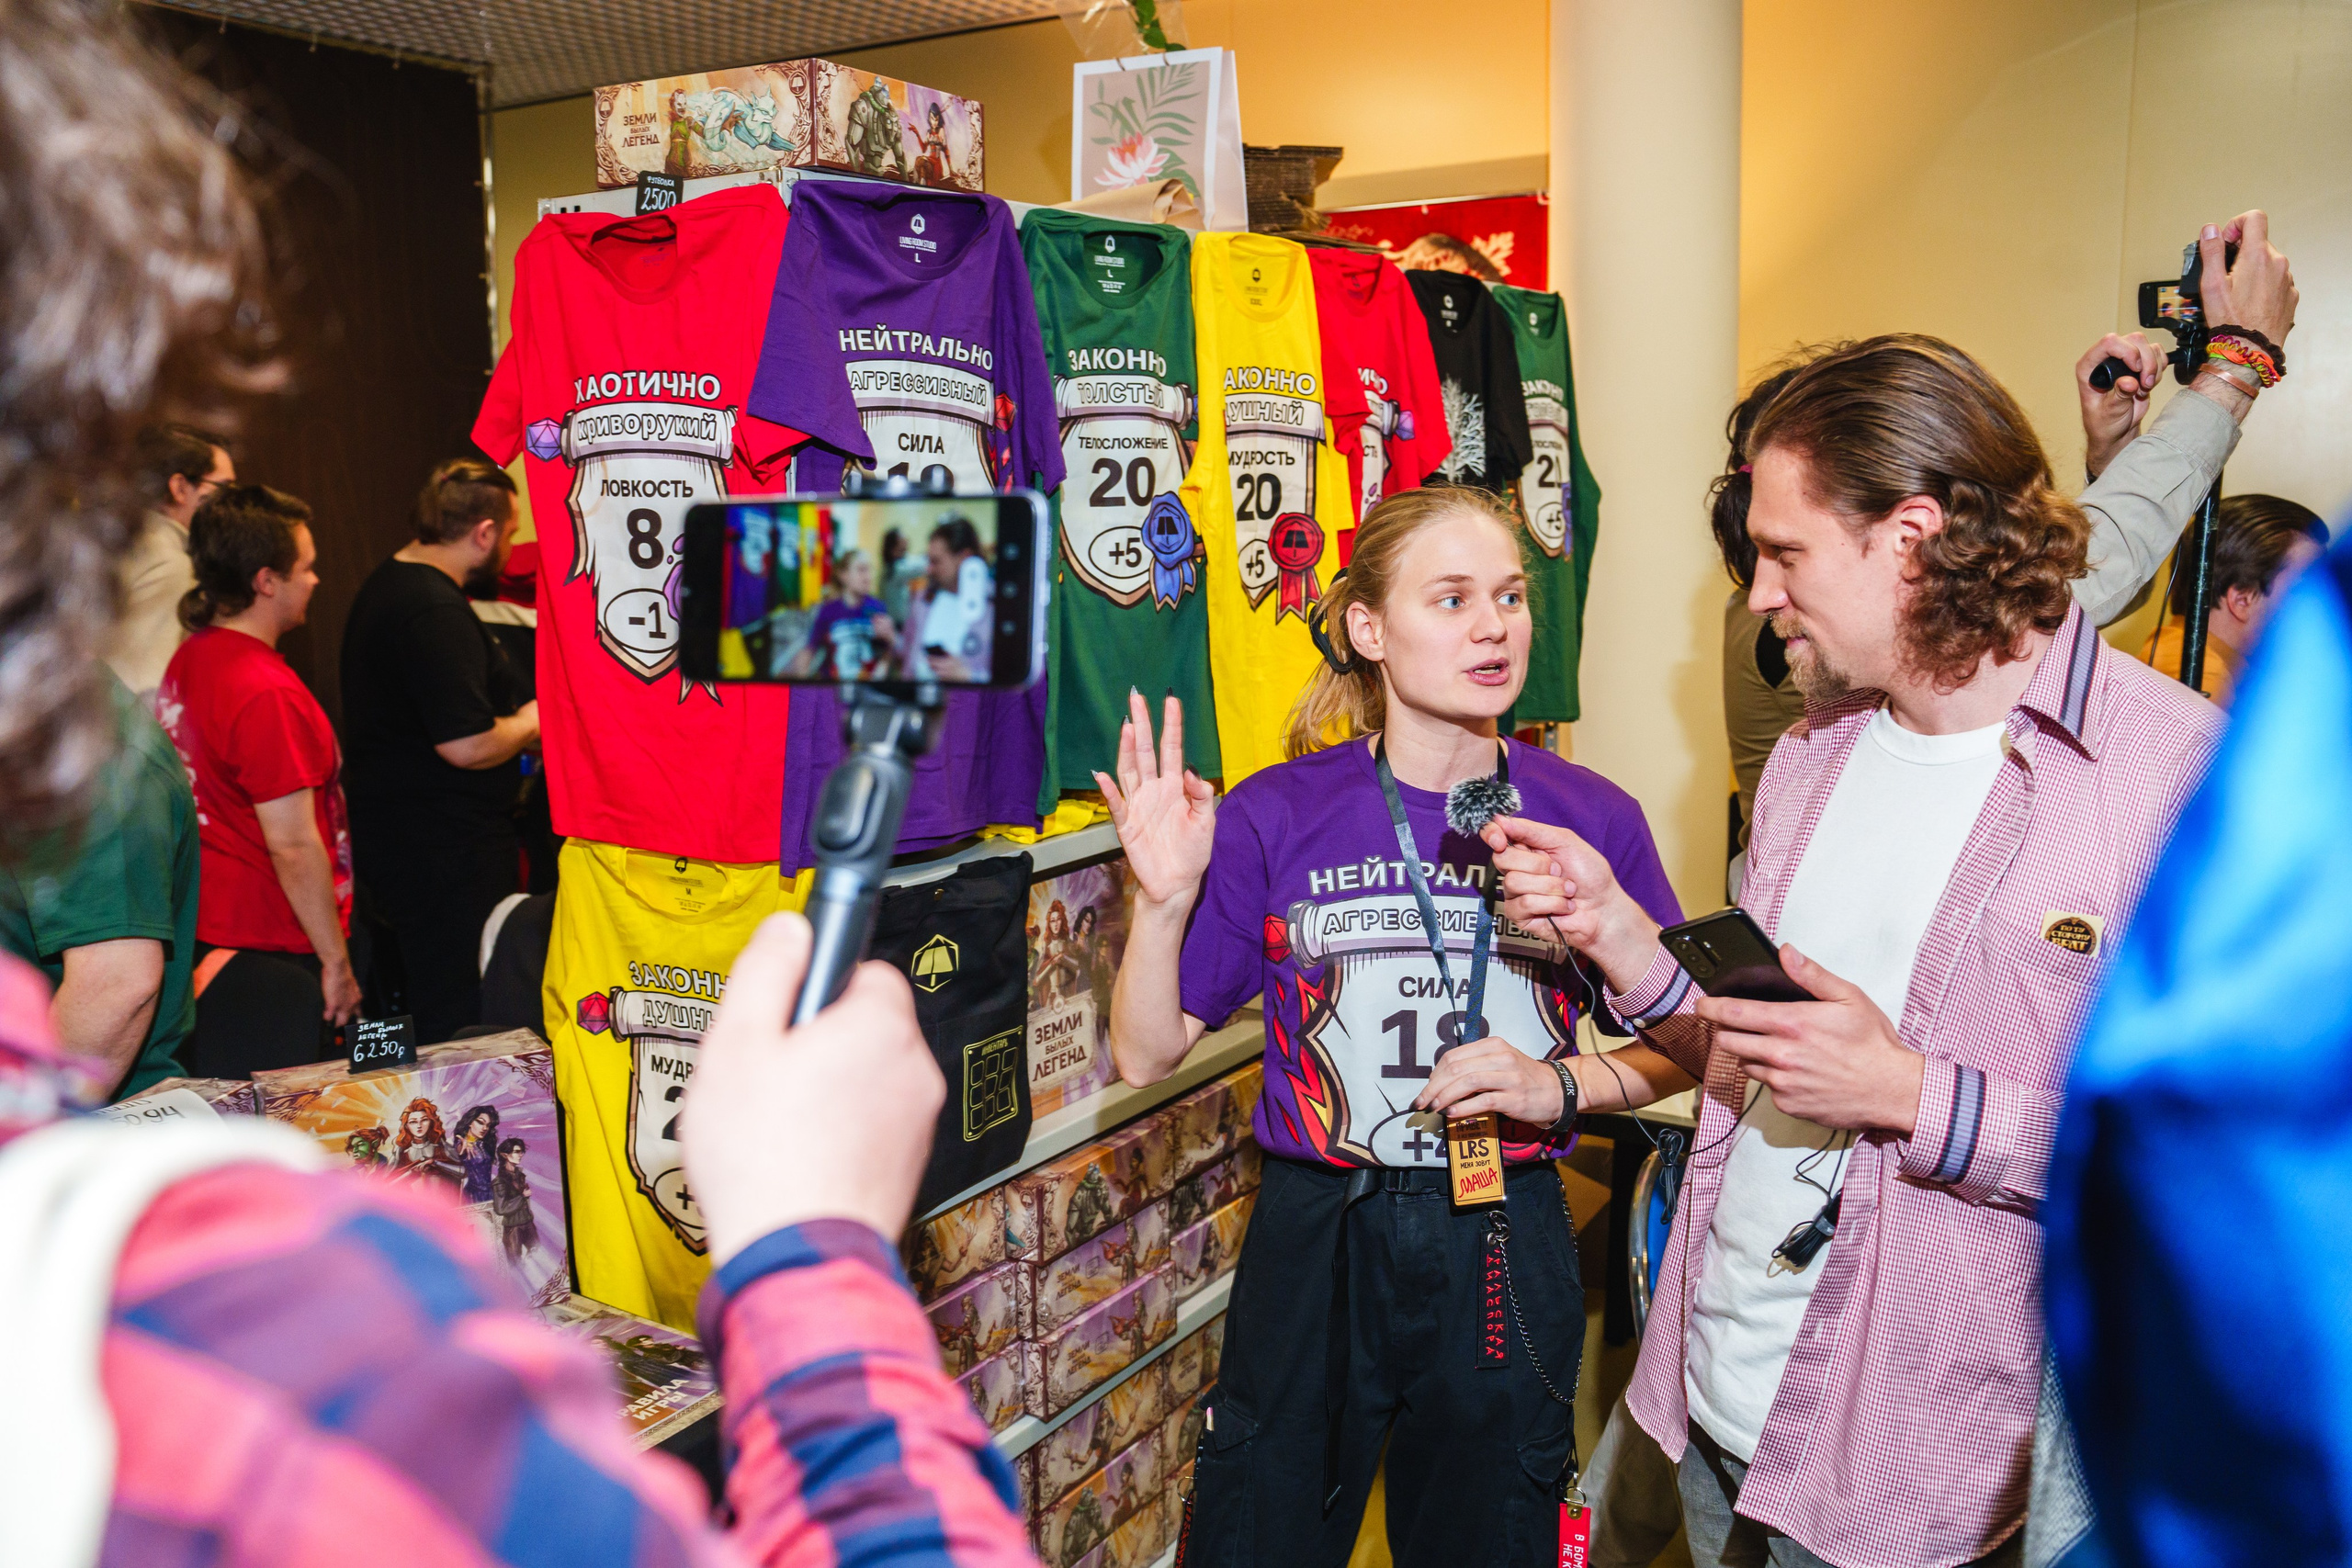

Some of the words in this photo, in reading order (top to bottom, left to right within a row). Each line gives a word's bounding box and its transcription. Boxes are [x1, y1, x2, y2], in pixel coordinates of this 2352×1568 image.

[623, 112, 657, 126] ЗЕМЛИ
[622, 134, 661, 147] ЛЕГЕНД
[640, 186, 677, 211] 2500
[915, 253, 922, 264] L
[838, 323, 995, 372] НЕЙТРАЛЬНО
[574, 370, 722, 406] ХАОТИЧНО
[850, 370, 988, 407] АГРЕССИВНЫЙ
[1223, 367, 1317, 396] АКОННО
[577, 412, 718, 445] криворукий
[898, 432, 945, 455] СИЛА
[600, 479, 694, 499] ЛОВКОСТЬ
[1090, 456, 1156, 508] 20
[1236, 473, 1282, 522] 20
[627, 508, 664, 570] 8
[1109, 536, 1143, 568] +5
[1246, 549, 1265, 579] +5
[628, 601, 668, 640] -1
[1307, 854, 1504, 897] НЕЙТРАЛ
[628, 961, 731, 999] ЗАКОНН
[1397, 976, 1471, 999] СИЛА
[643, 999, 715, 1033] ДУШН
[1035, 1011, 1082, 1044] ЗЕМЛИ
[1046, 1035, 1074, 1055] БЫЛЫХ
[650, 1055, 700, 1082] МУДР
[1032, 1045, 1087, 1082] ЛЕГЕНД
[1555, 1062, 1575, 1096] СТНИК
[1458, 1138, 1490, 1160] LRS
[1476, 1159, 1490, 1168] ЗОВУТ
[1458, 1167, 1498, 1199] МАША
[632, 1391, 688, 1421] ИГРЫ
[1563, 1543, 1573, 1559] НЕ
[1572, 1546, 1584, 1568] БОМ
